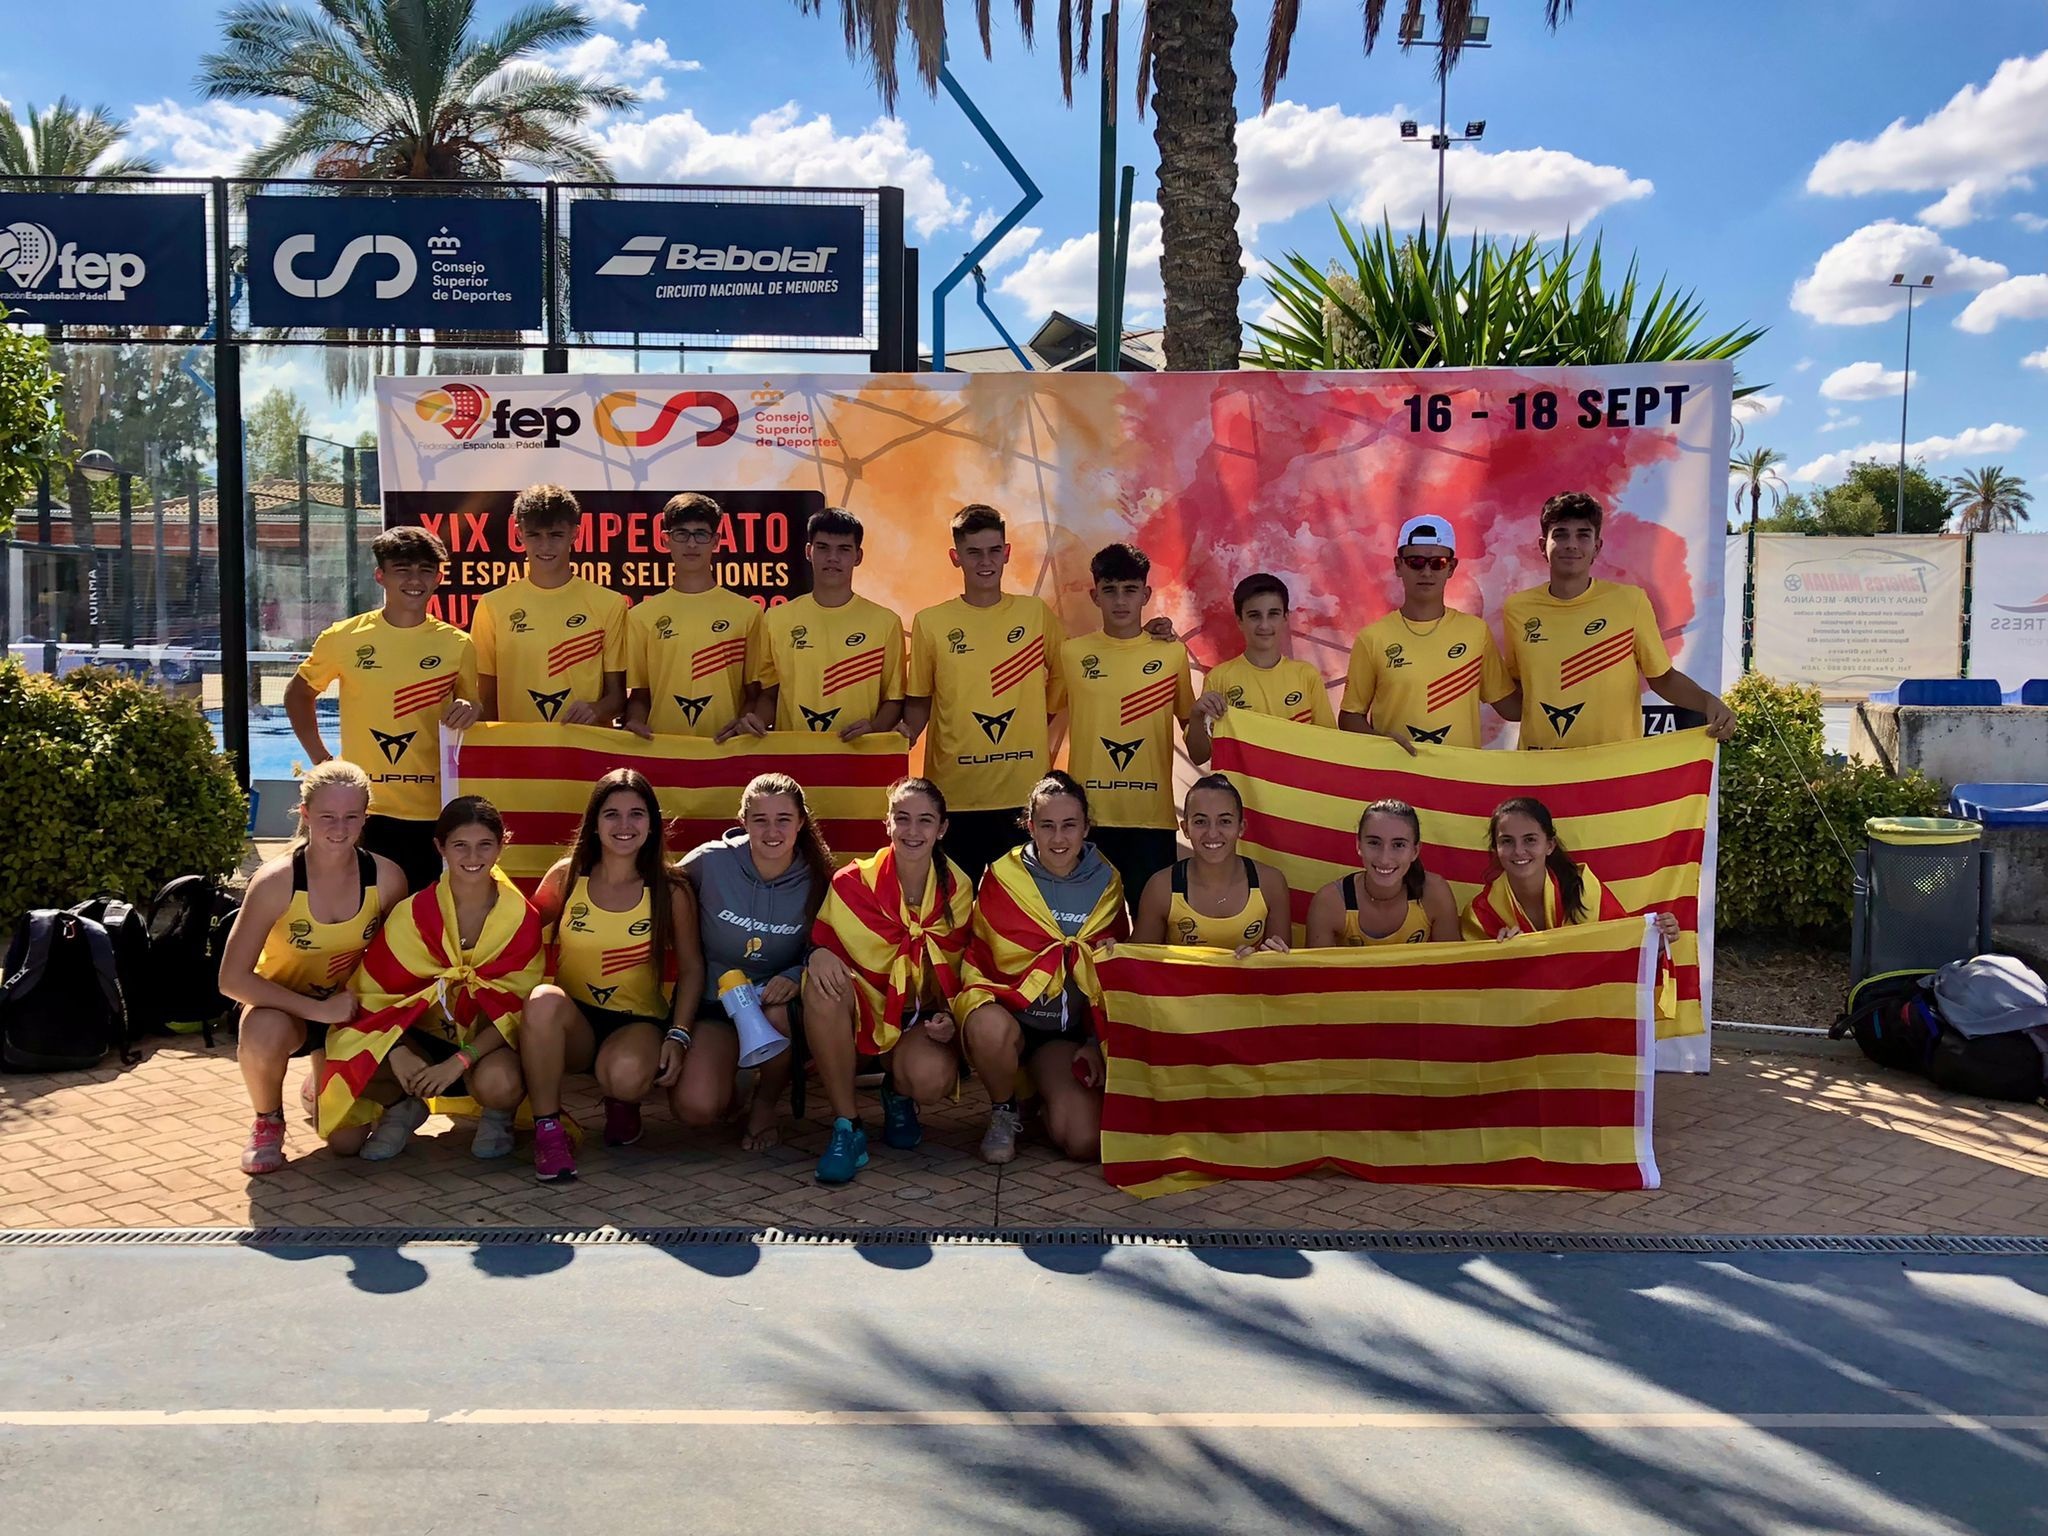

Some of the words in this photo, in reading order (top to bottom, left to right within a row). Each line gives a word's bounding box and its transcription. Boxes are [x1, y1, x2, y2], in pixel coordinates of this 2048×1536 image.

[58, 242, 146, 300] fep
[432, 261, 485, 275] Consejo
[433, 275, 489, 289] Superior
[656, 284, 707, 298] CIRCUITO
[709, 281, 765, 297] NACIONAL
[768, 282, 783, 295] DE
[785, 280, 839, 293] MENORES
[432, 289, 449, 300] de
[452, 289, 512, 303] Deportes
[1404, 394, 1452, 433] 16
[1508, 391, 1558, 430] 18
[1577, 385, 1690, 429] SEPT
[493, 399, 580, 448] fep
[755, 411, 810, 424] Consejo
[756, 424, 813, 436] Superior
[756, 437, 773, 446] de
[777, 437, 838, 448] Deportes
[420, 513, 491, 553] XIX
[958, 751, 1033, 764] CUPRA
[1086, 780, 1158, 791] CUPRA
